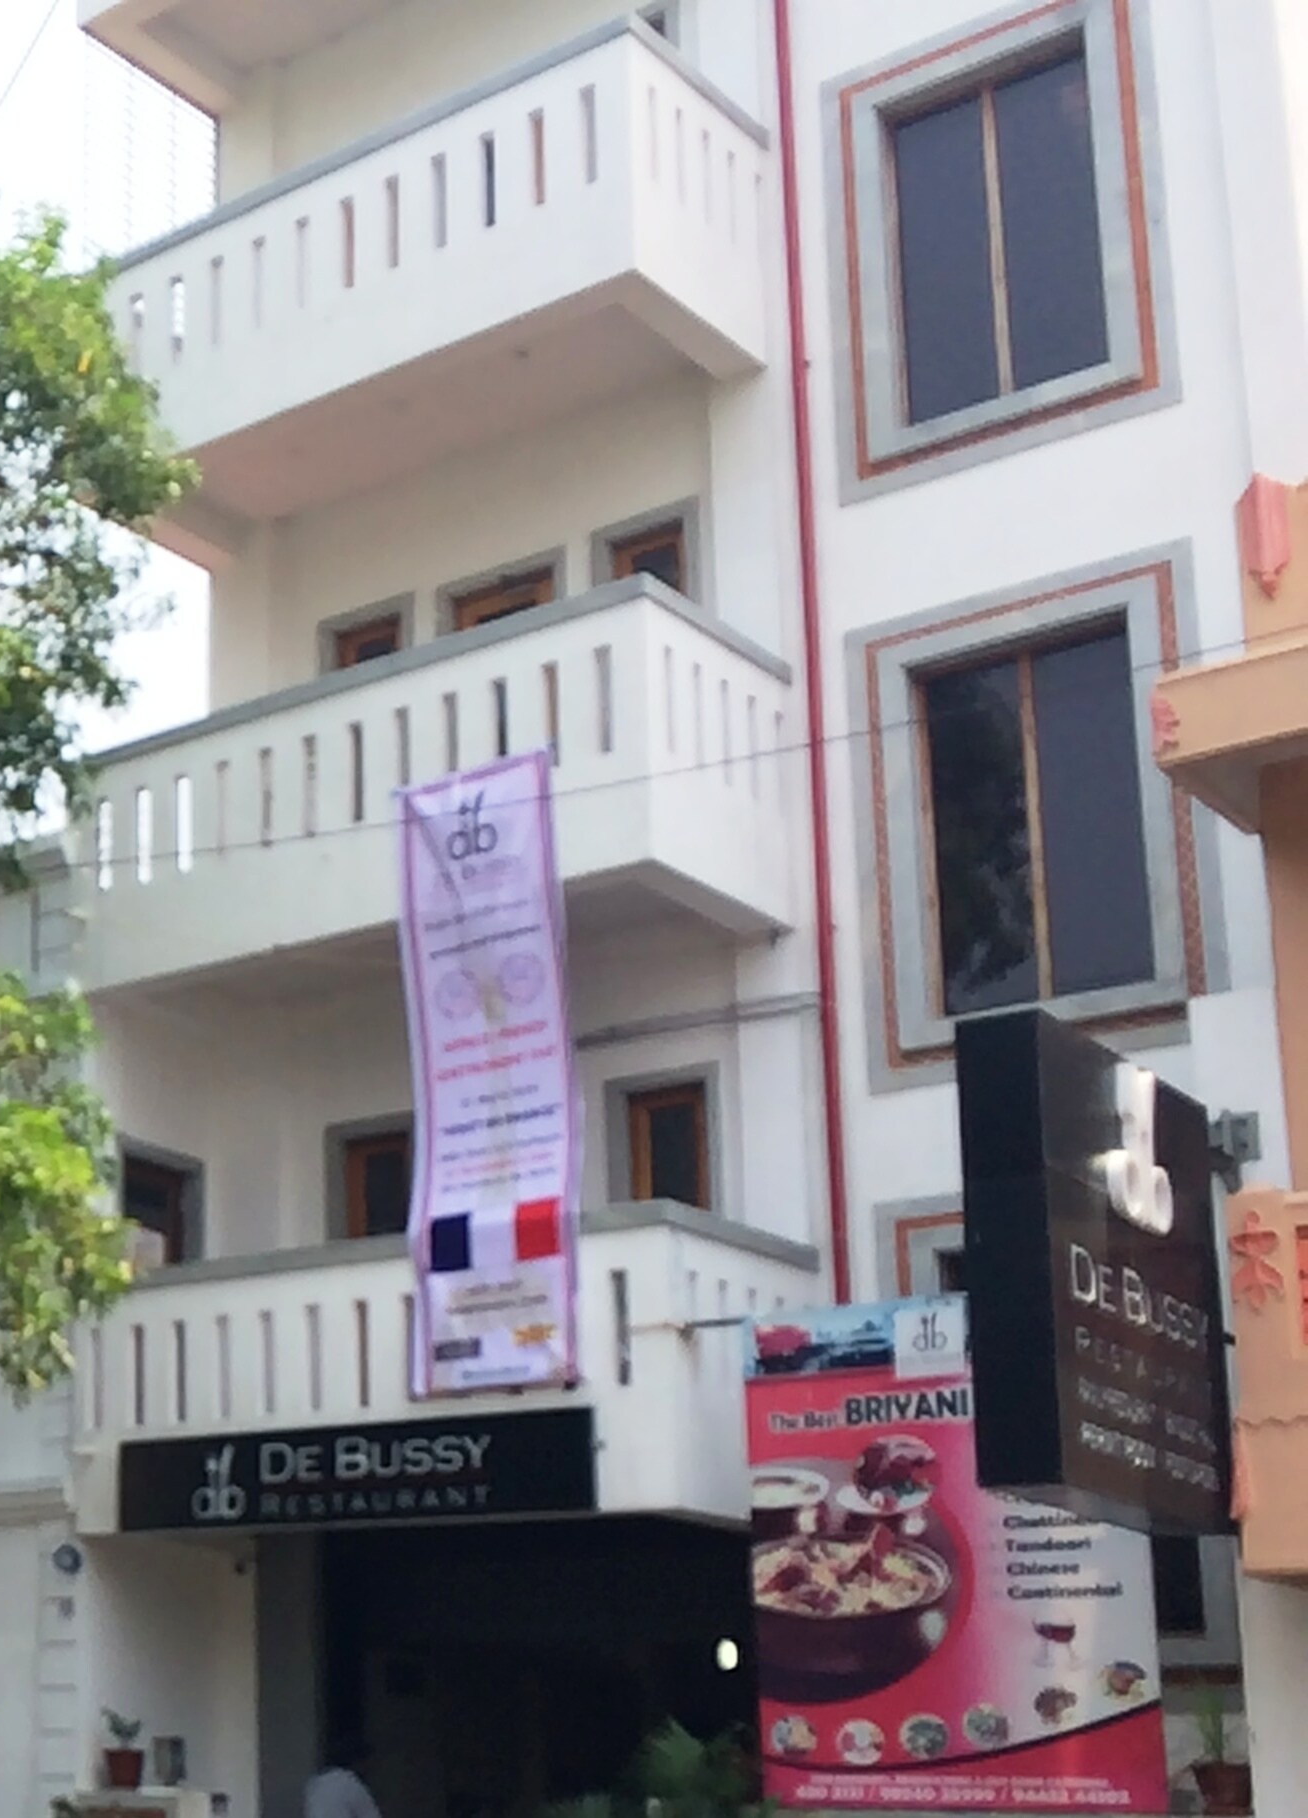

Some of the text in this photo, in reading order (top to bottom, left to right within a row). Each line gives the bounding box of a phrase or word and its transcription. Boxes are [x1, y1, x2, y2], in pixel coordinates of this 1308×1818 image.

[844, 1388, 969, 1426] BRIYANI
[334, 1434, 491, 1480] BUSSY
[1006, 1561, 1080, 1576] Chinese
